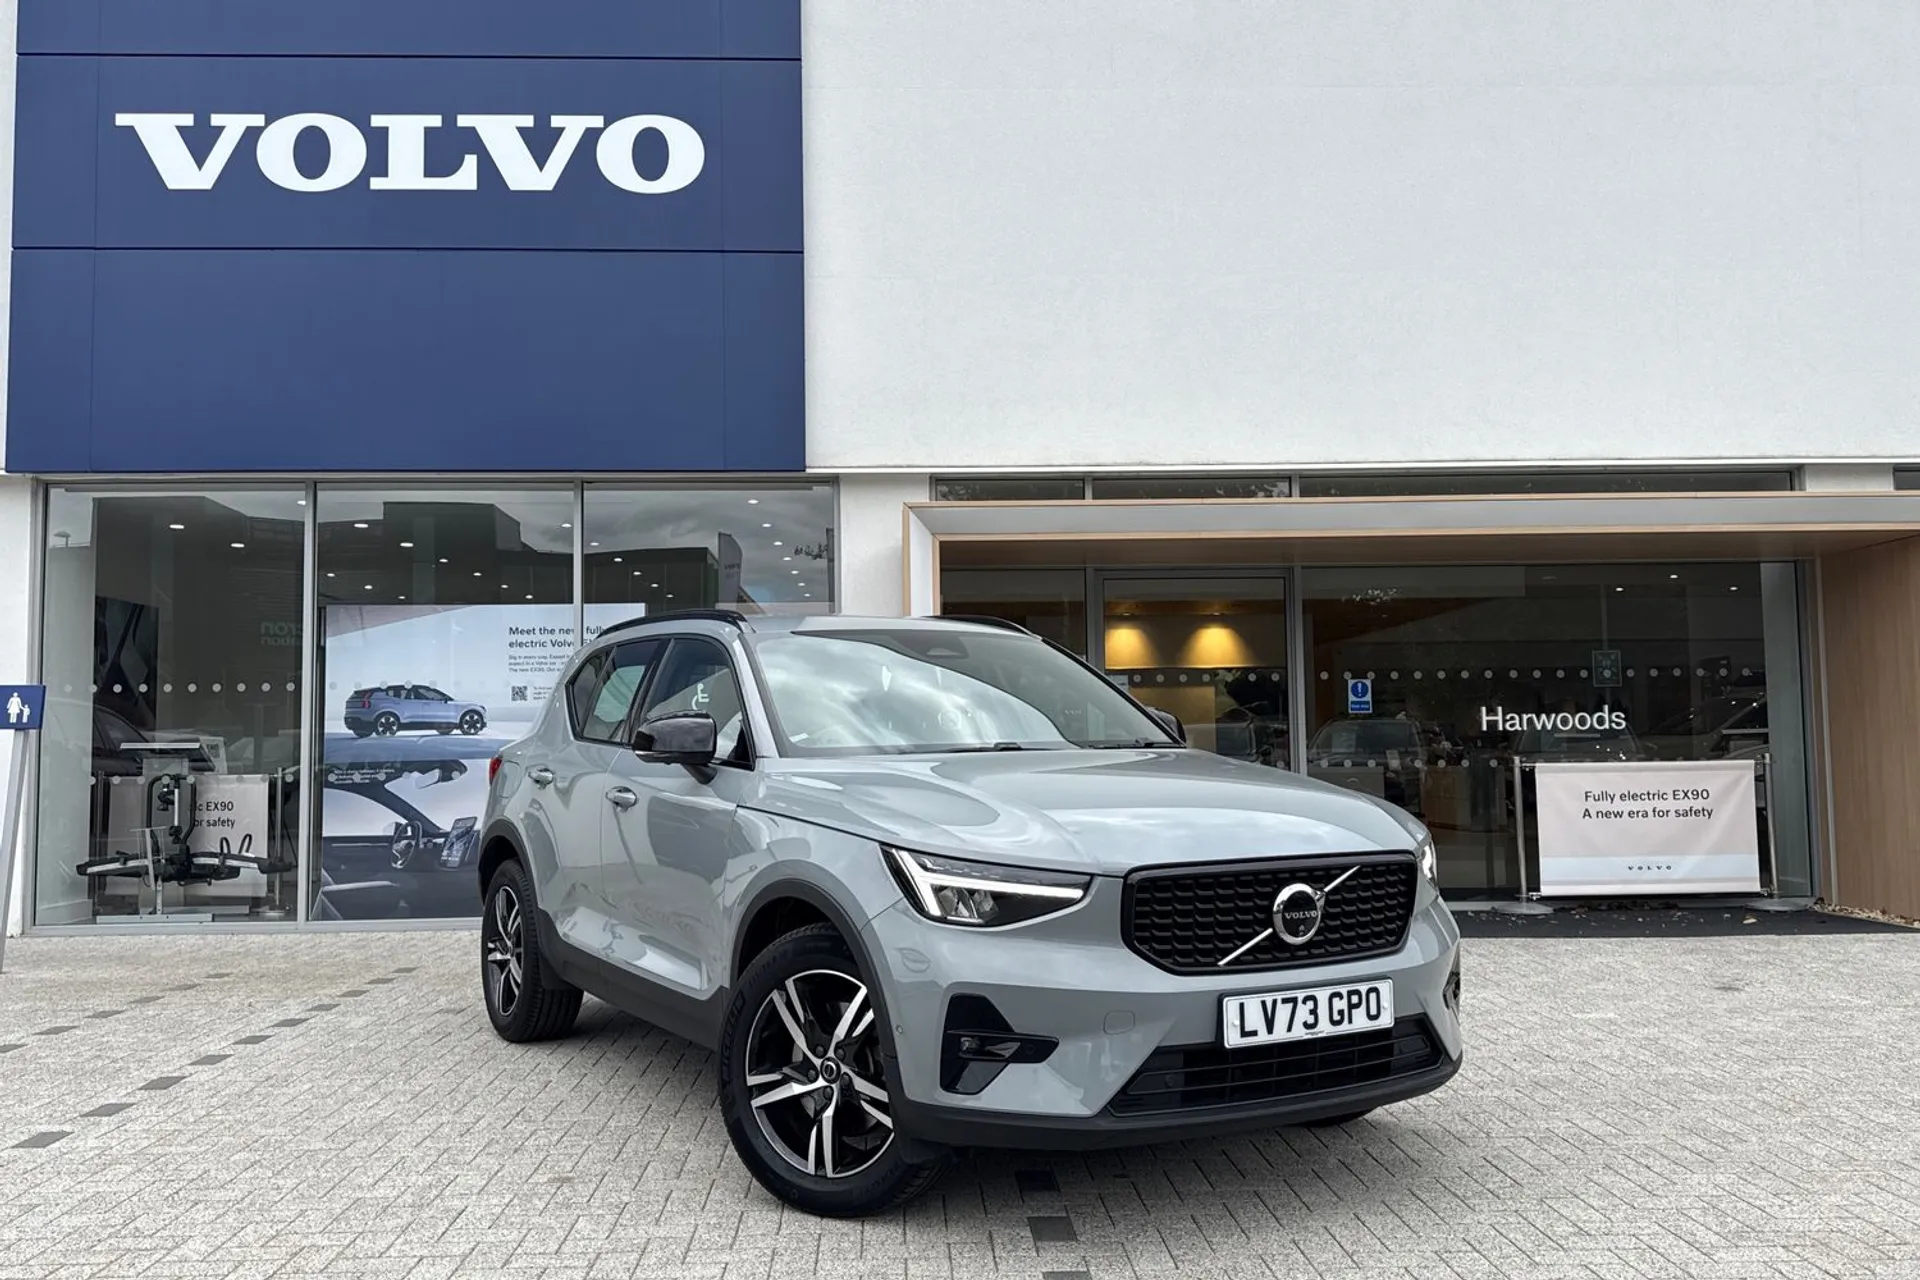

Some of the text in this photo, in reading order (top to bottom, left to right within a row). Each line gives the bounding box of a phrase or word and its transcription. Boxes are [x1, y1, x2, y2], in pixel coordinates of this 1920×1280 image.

[115, 112, 705, 194] VOLVO
[508, 625, 604, 635] Meet the ne full
[508, 639, 547, 648] electric
[550, 639, 574, 648] Volv
[1480, 704, 1626, 731] Harwoods
[1584, 788, 1710, 804] Fully electric EX90
[206, 801, 234, 811] EX90
[1582, 806, 1713, 819] A new era for safety
[206, 817, 236, 829] safety
[1284, 910, 1317, 919] VOLVO
[1239, 986, 1381, 1038] LV73 GPO
